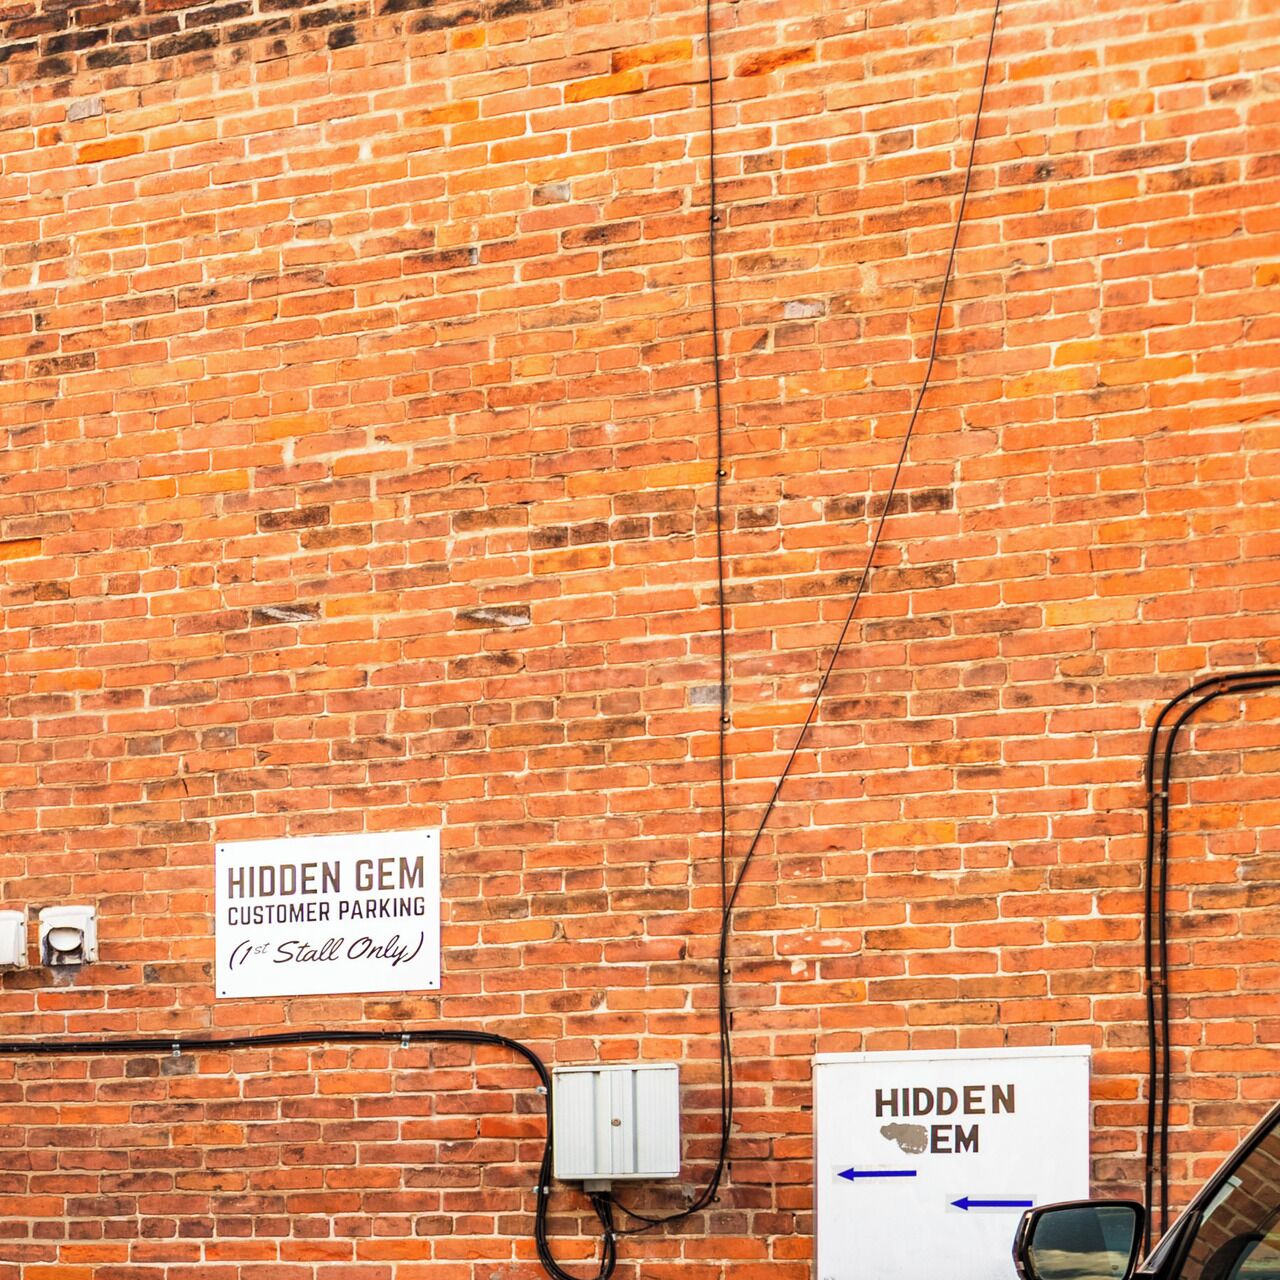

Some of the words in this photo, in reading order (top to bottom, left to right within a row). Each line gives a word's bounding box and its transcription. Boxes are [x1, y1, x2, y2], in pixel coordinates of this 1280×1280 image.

[228, 860, 340, 899] HIDDEN
[355, 856, 424, 892] GEM
[228, 901, 330, 926] CUSTOMER
[339, 897, 425, 920] PARKING
[273, 937, 344, 964] Stall
[346, 931, 425, 967] Only)
[875, 1084, 1015, 1117] HIDDEN
[902, 1123, 979, 1154] EM
